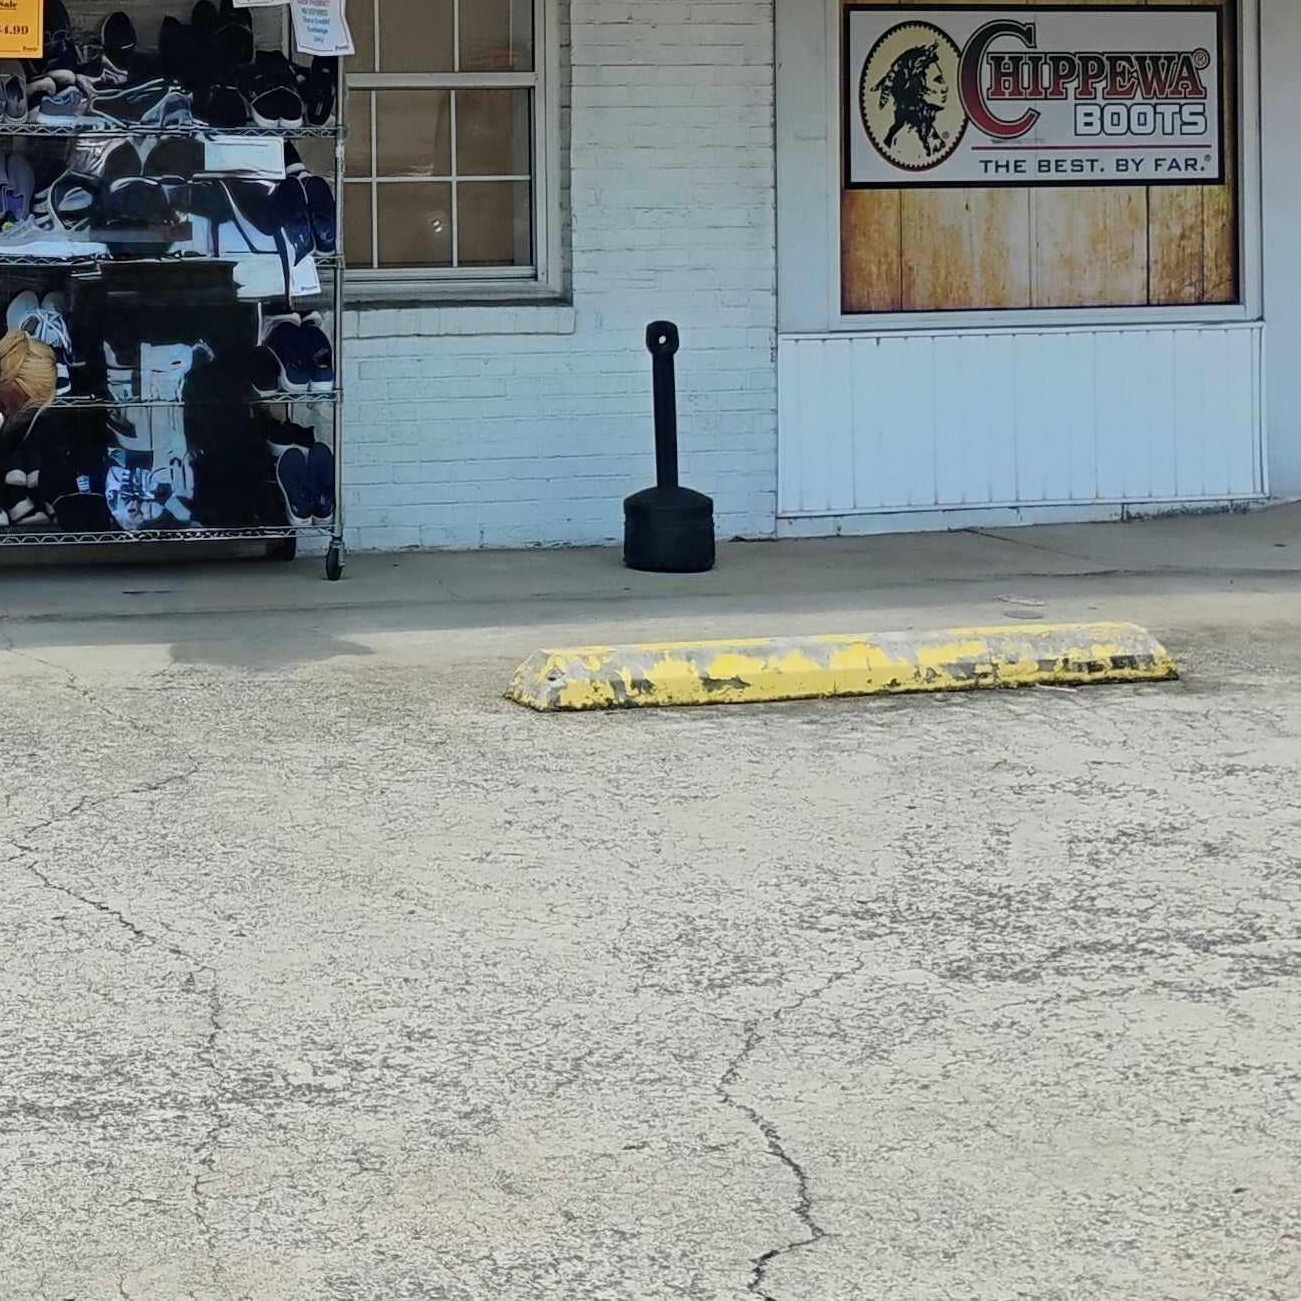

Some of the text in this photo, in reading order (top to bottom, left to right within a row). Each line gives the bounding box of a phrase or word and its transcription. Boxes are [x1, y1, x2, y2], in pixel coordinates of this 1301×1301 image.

[957, 19, 1207, 139] CHIPPEWA
[1074, 103, 1207, 136] BOOTS
[979, 159, 1027, 173] THE
[1037, 158, 1105, 173] BEST.
[1115, 158, 1145, 172] BY
